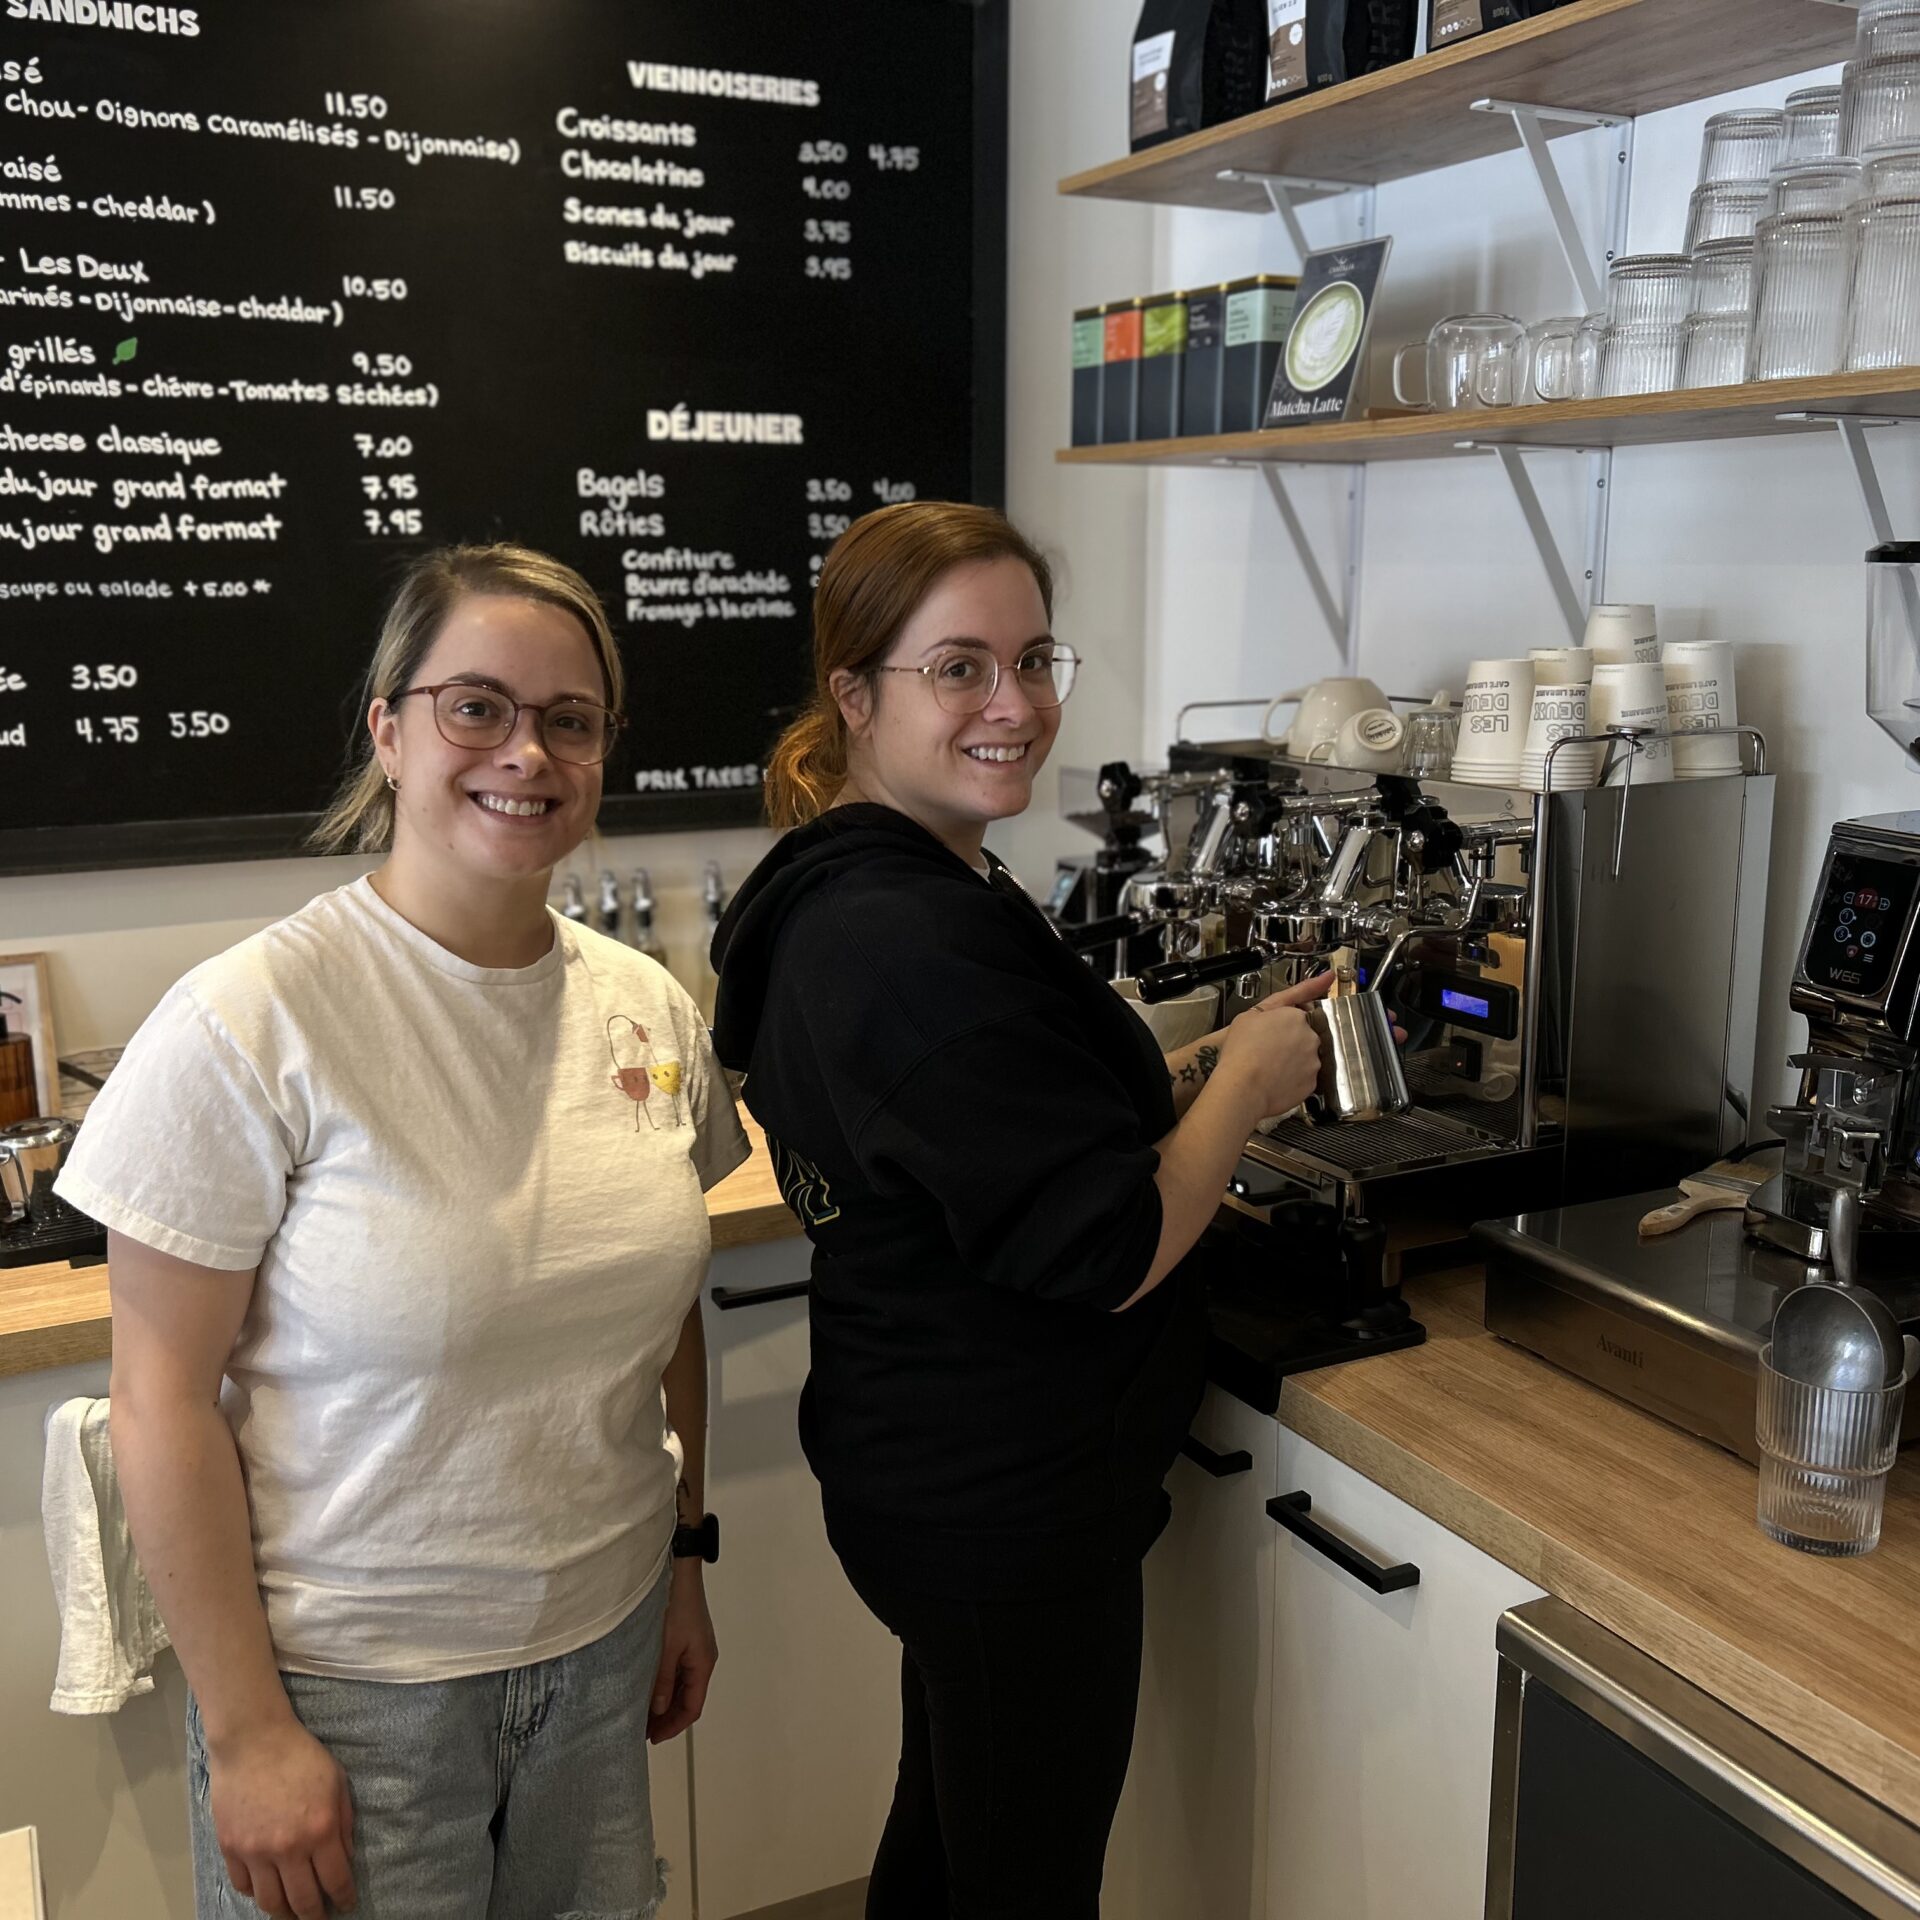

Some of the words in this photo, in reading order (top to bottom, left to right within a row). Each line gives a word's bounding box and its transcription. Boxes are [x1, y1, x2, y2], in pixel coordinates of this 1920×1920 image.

[7, 0, 200, 36] SANDWICHS
[627, 61, 819, 106] VIENNOISERIES
[94, 97, 202, 131] Oignons
[325, 92, 387, 119] 11.50
[556, 107, 698, 147] Croissants
[561, 149, 705, 187] Chocolatine
[334, 186, 395, 210] 11.50
[563, 197, 648, 227] Scones
[649, 201, 682, 231] du
[683, 209, 734, 238] jour
[20, 248, 72, 275] Les
[77, 255, 149, 283] Deux
[564, 241, 654, 268] Biscuits
[658, 244, 689, 269] du
[691, 251, 736, 278] jour
[343, 276, 407, 300] 10.50
[6, 334, 97, 370] grillés
[352, 352, 412, 376] 9.50
[1272, 397, 1311, 417] Matcha
[1312, 396, 1343, 414] Latte
[647, 403, 803, 443] DÉJEUNER
[0, 424, 86, 452] cheese
[97, 425, 222, 465] classique
[354, 434, 412, 458] 7.00
[36, 470, 98, 502] jour
[113, 472, 186, 509] grand
[190, 472, 287, 500] format
[362, 474, 418, 500] 7.95
[577, 467, 665, 511] Bagels
[91, 510, 174, 556] grand
[176, 513, 282, 541] format
[364, 509, 422, 534] 7.95
[580, 508, 666, 537] Rôties
[0, 583, 58, 600] soupe
[65, 583, 92, 595] ou
[99, 580, 172, 598] salade
[72, 665, 137, 690] 3.50
[1489, 680, 1510, 690] CAFÉ
[1569, 689, 1586, 698] CAFÉ
[1470, 714, 1509, 734] LES
[1533, 701, 1586, 721] DEUX
[1680, 713, 1720, 730] LES
[76, 716, 139, 743] 4.75
[169, 711, 229, 738] 5.50
[1546, 723, 1586, 743] LES
[1596, 1333, 1644, 1369] Avanti
